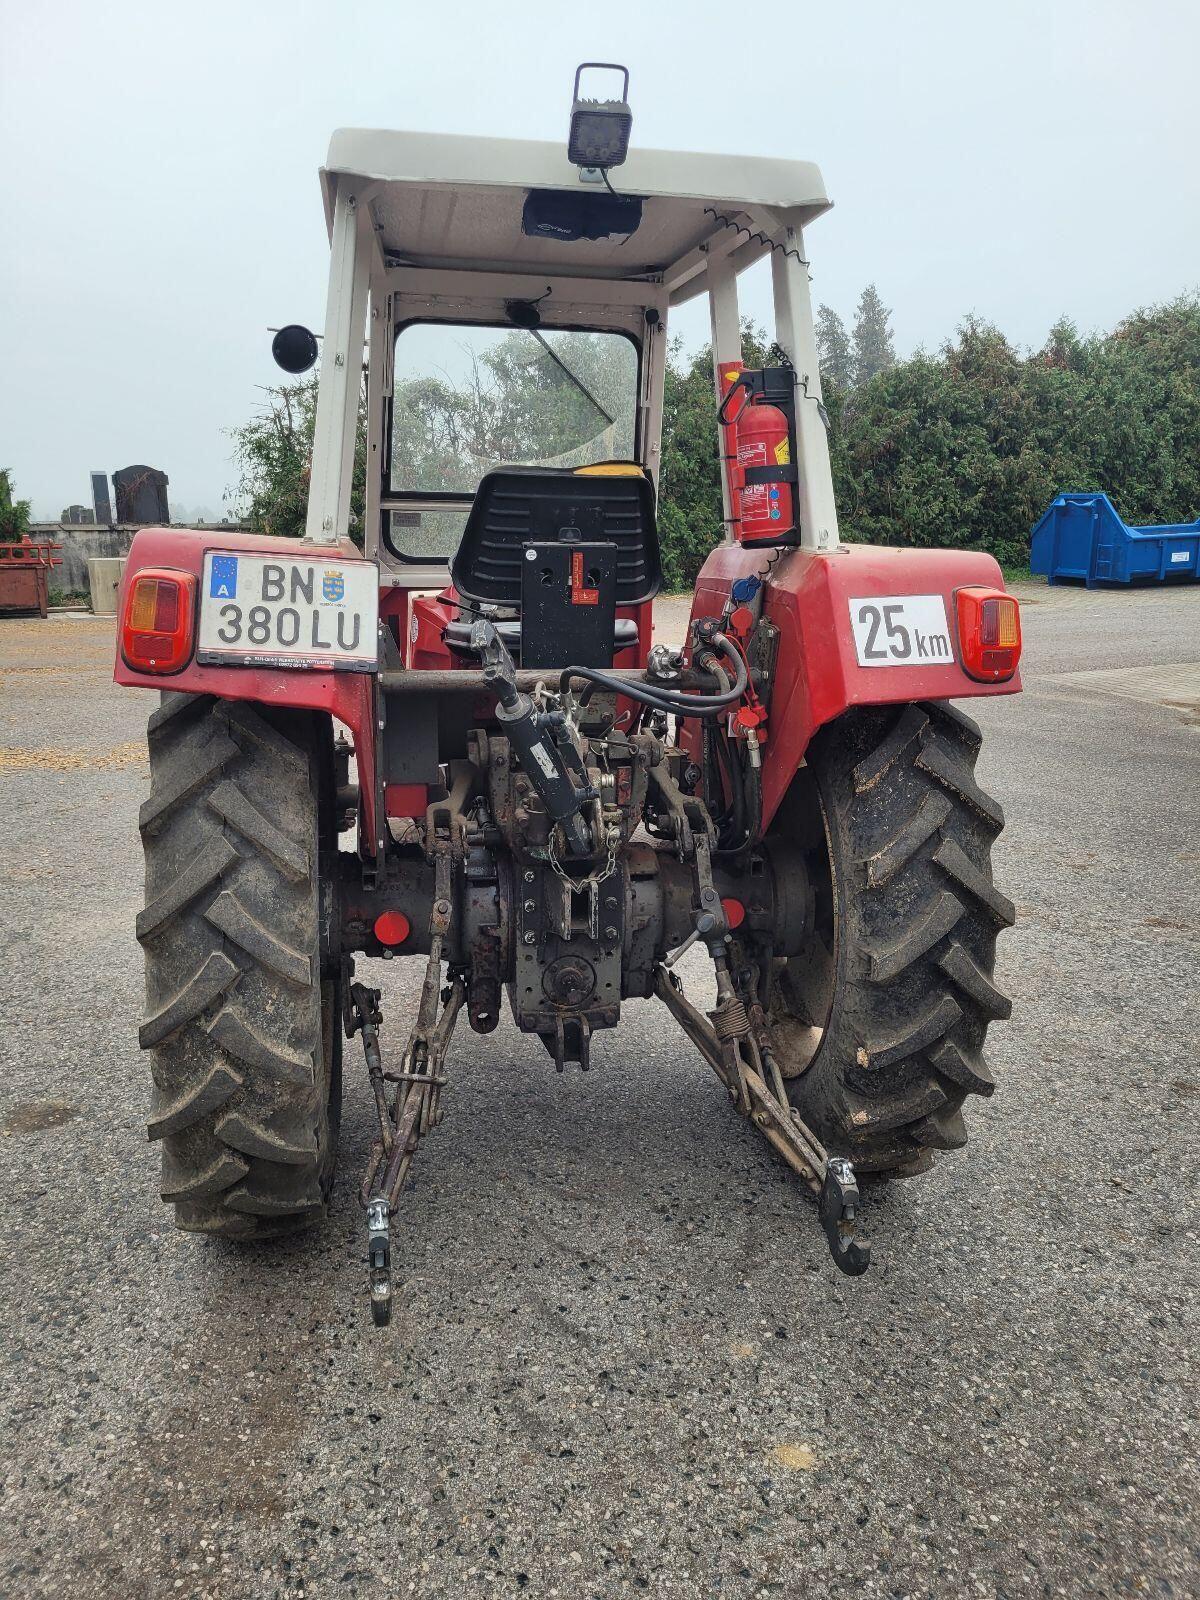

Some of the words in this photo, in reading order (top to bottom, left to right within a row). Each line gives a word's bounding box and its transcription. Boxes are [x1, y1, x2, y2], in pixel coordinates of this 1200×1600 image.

[217, 584, 230, 597] A
[262, 564, 314, 604] BN
[217, 604, 300, 646] 380
[312, 609, 361, 650] LU
[858, 604, 912, 660] 25
[914, 628, 949, 657] km
